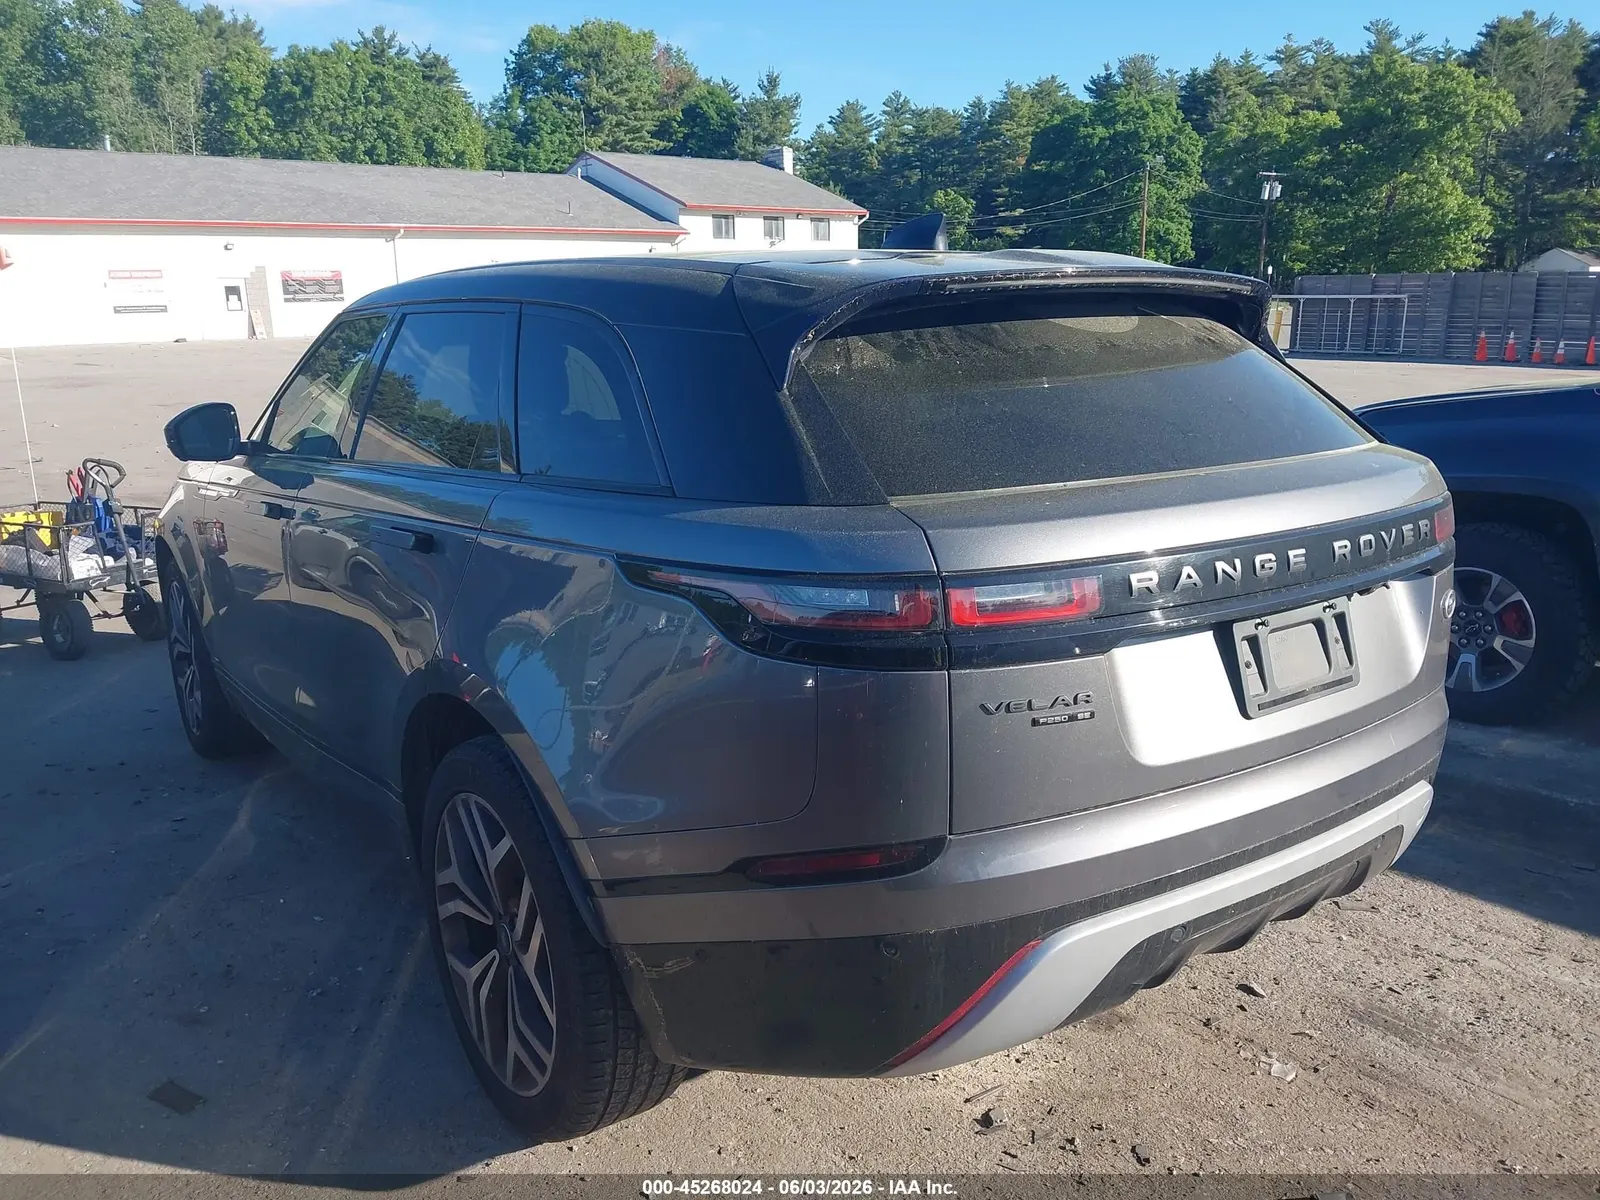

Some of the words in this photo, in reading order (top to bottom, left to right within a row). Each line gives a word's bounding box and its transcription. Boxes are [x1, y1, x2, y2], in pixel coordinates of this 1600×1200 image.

[1130, 548, 1307, 597] RANGE
[1332, 518, 1431, 564] ROVER
[979, 691, 1094, 716] VELAR
[1039, 714, 1069, 726] P250
[1077, 711, 1092, 721] SE
